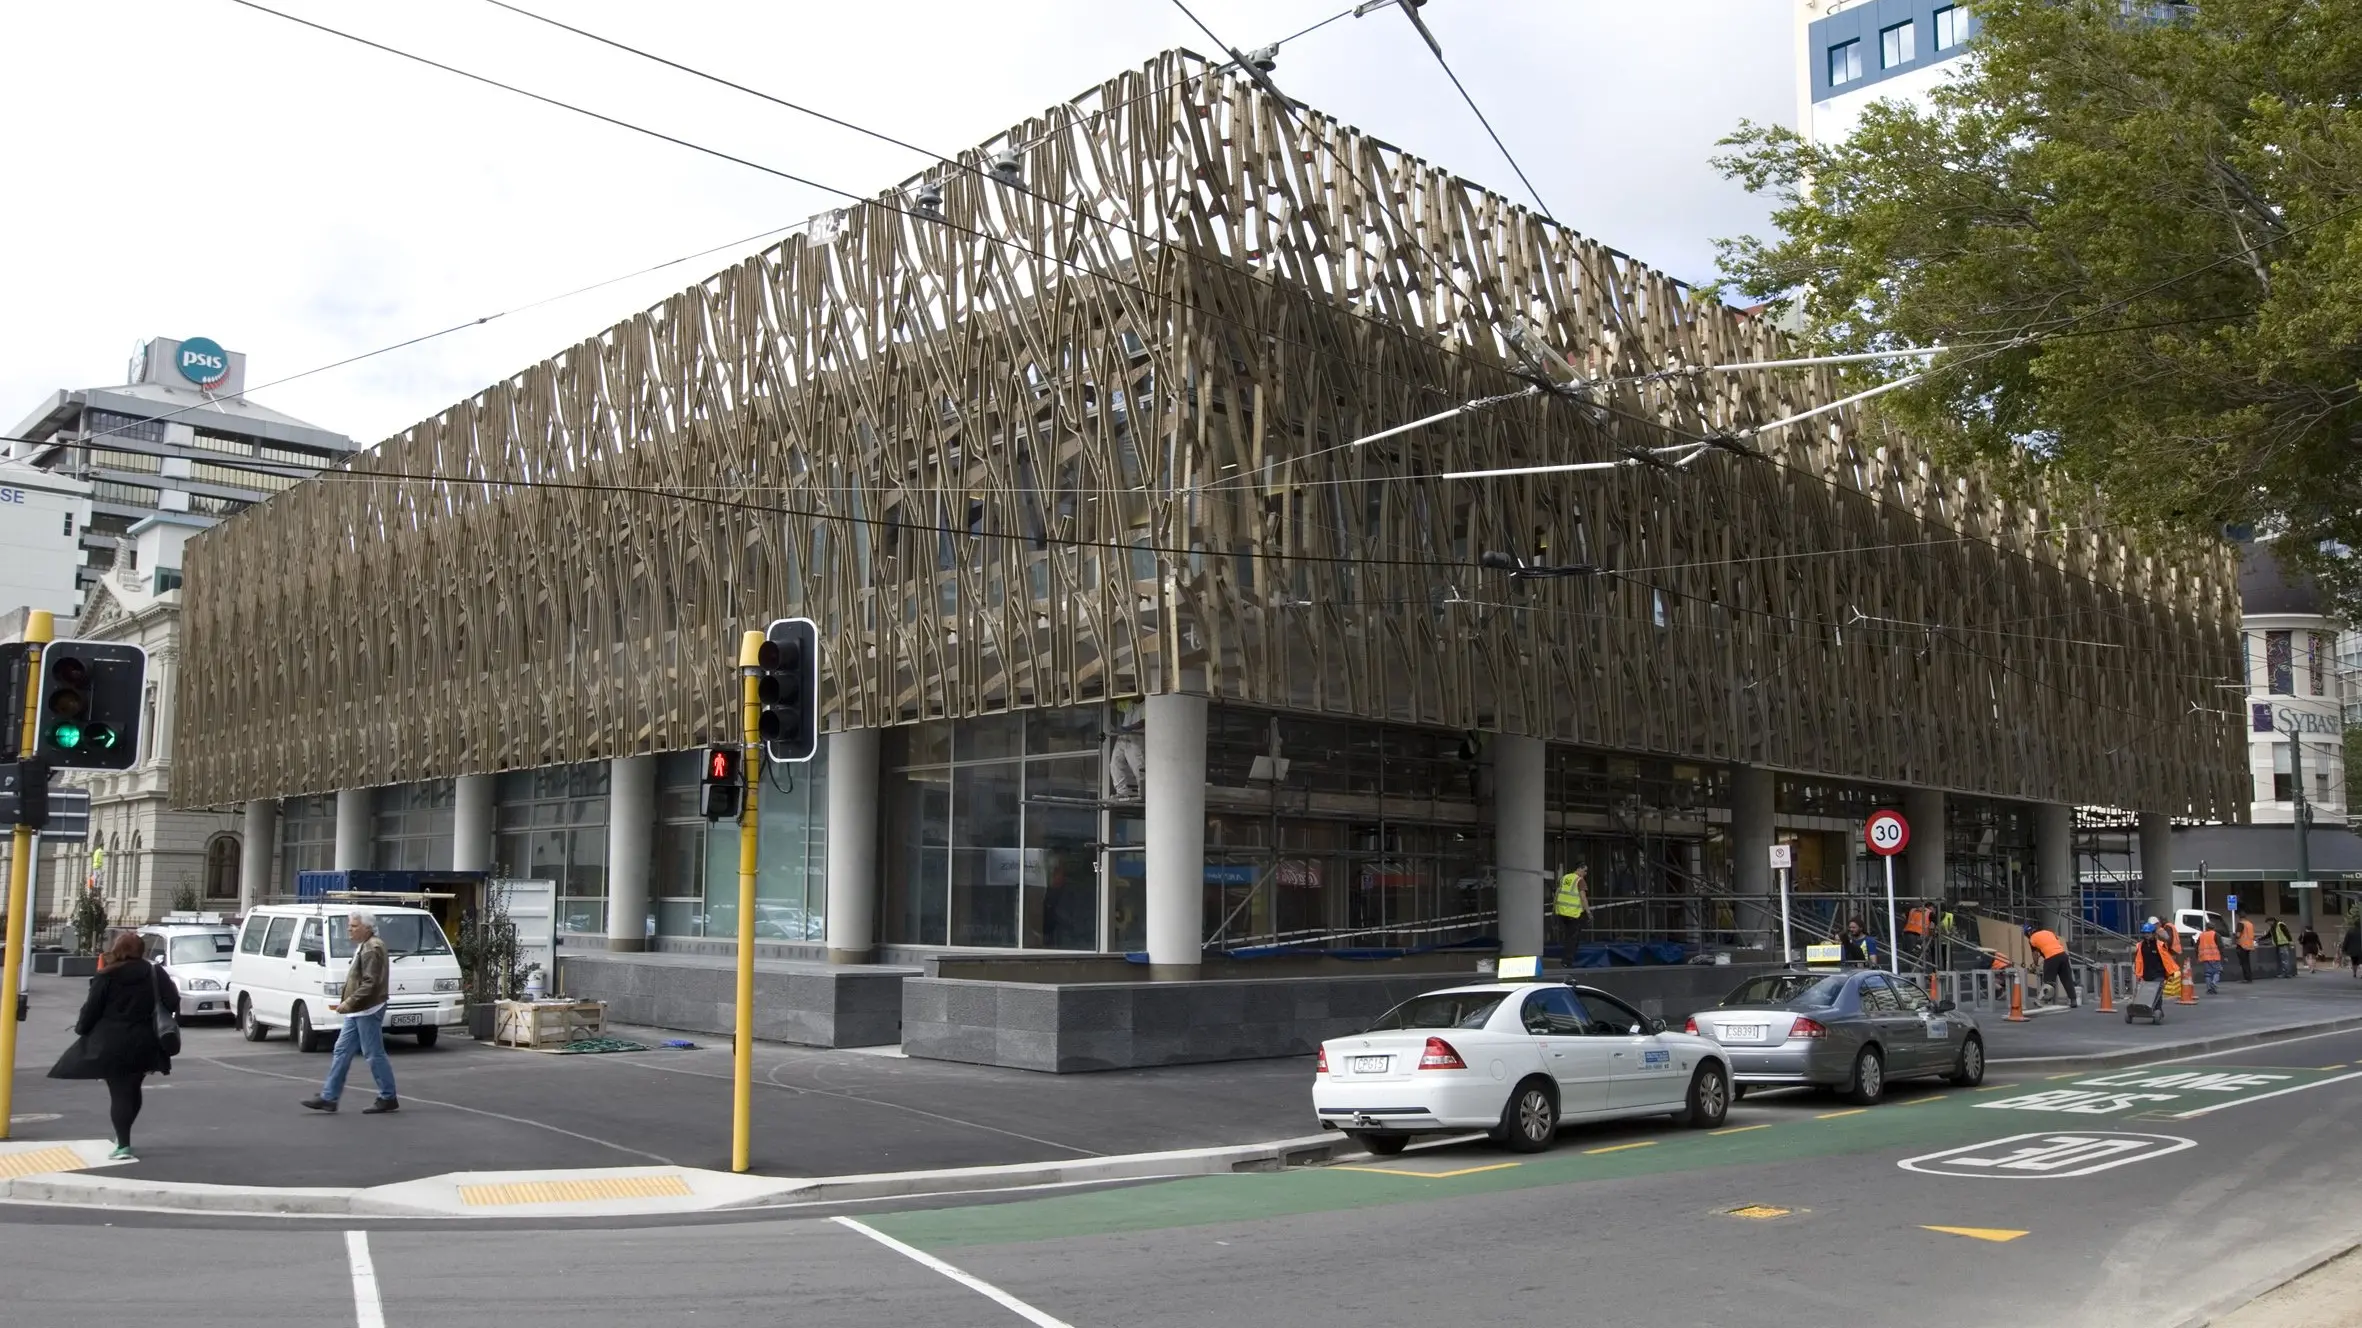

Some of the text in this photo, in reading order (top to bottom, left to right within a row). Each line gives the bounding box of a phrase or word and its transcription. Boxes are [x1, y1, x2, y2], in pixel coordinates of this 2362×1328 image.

[2279, 708, 2339, 735] SYBASE
[1876, 824, 1899, 841] 30
[1727, 1026, 1756, 1037] CSB391
[2072, 1071, 2293, 1091] LANE
[1971, 1089, 2181, 1114] BUS
[1942, 1136, 2154, 1171] 30
